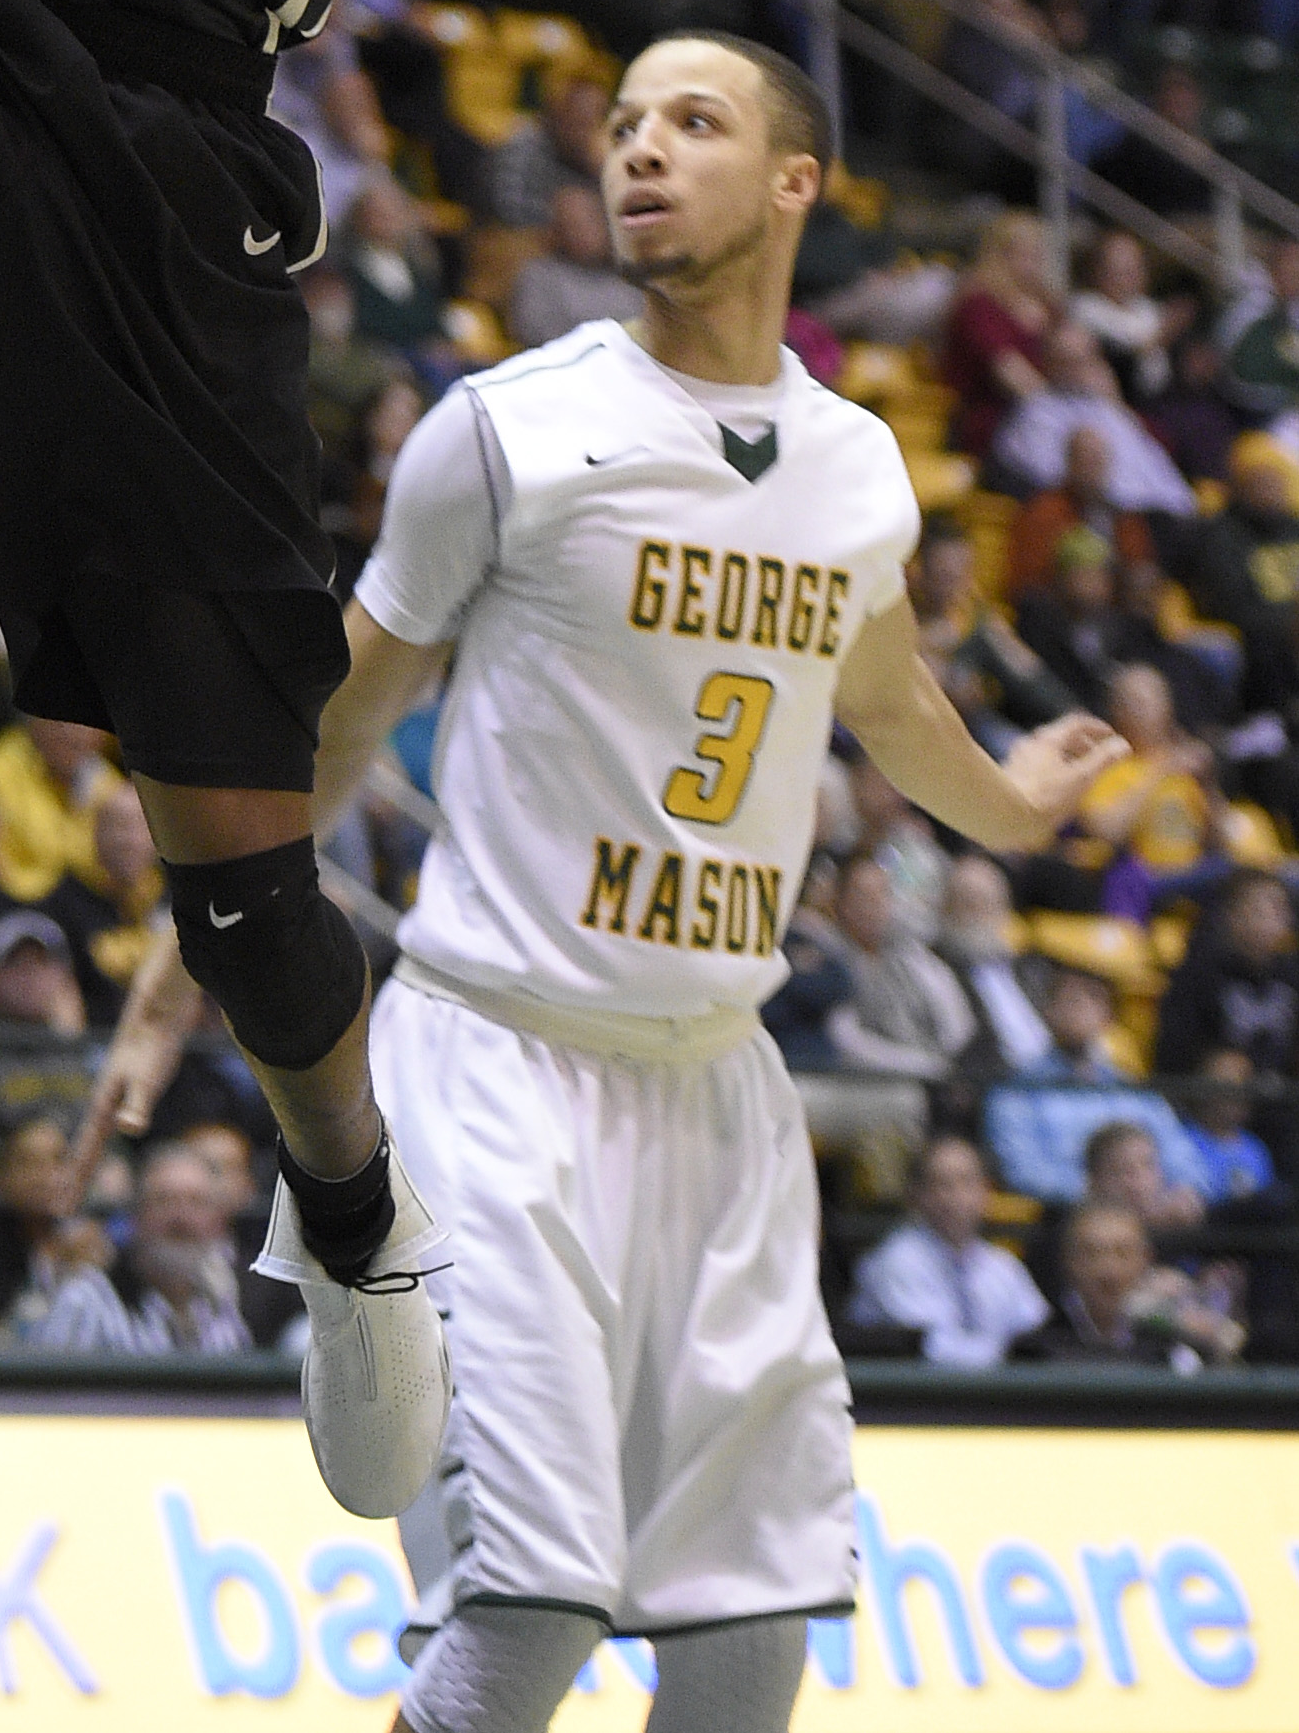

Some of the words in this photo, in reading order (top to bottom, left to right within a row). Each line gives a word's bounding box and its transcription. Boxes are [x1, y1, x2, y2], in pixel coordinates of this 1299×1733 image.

[628, 538, 852, 659] GEORGE
[663, 670, 775, 826] 3
[580, 834, 784, 959] MASON
[808, 1489, 1258, 1691] here
